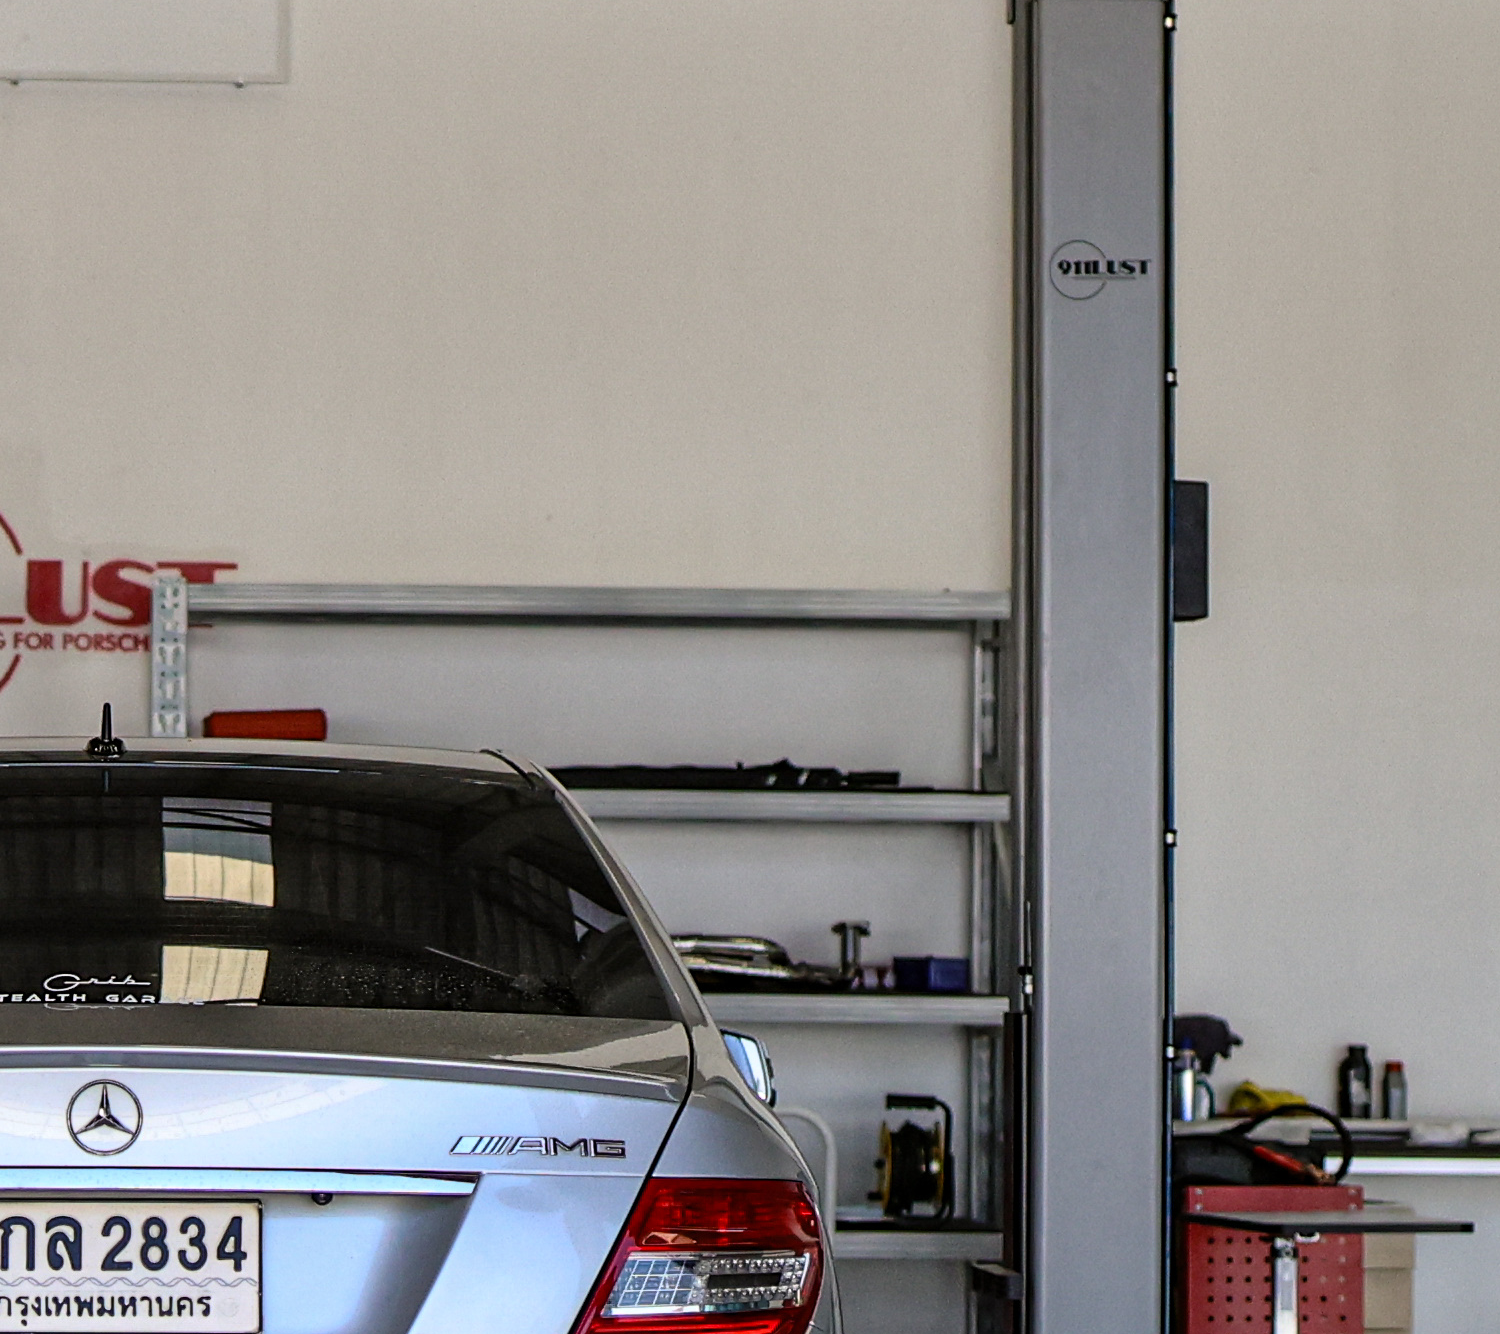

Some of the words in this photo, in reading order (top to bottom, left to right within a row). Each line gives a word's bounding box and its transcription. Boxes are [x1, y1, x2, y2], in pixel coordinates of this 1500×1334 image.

[1058, 258, 1151, 275] 911LUST
[13, 631, 54, 651] FOR
[62, 632, 150, 653] PORSCH
[507, 1136, 626, 1158] AMG
[101, 1215, 248, 1272] 2834
